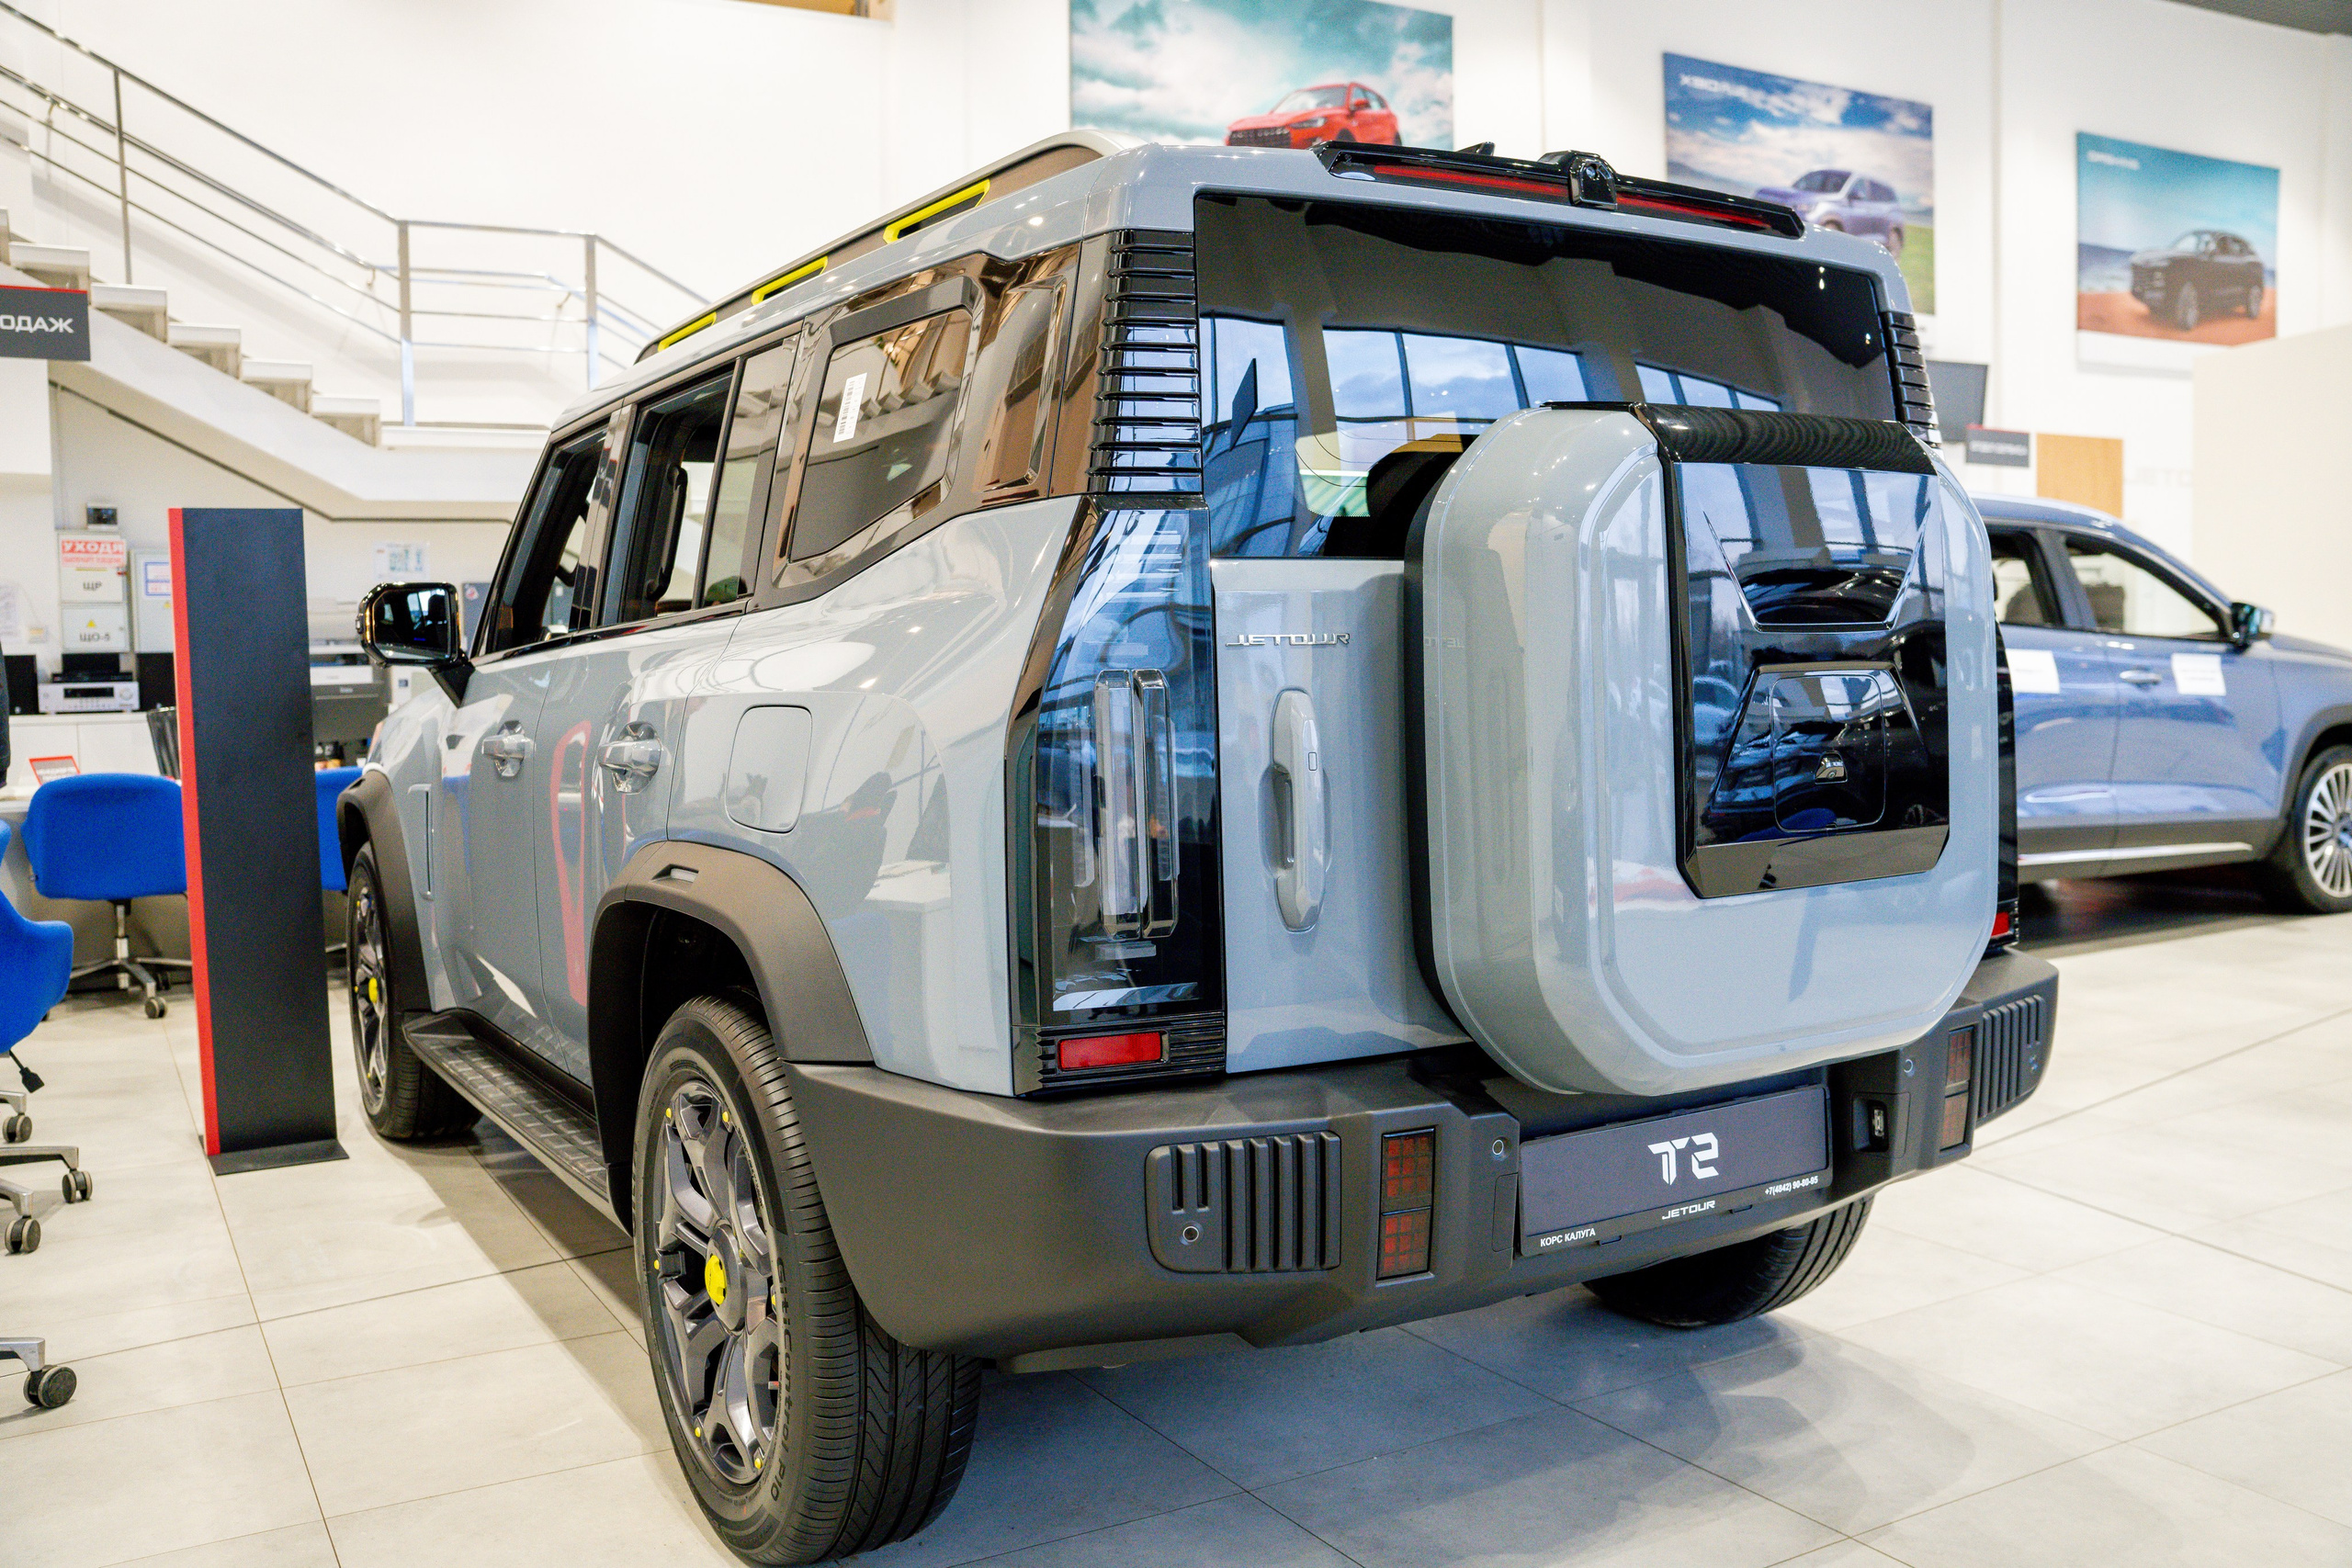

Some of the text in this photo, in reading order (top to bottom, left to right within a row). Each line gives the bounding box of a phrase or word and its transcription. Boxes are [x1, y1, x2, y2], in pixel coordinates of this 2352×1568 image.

[1227, 633, 1351, 646] JETOUR
[1647, 1133, 1719, 1185] T2
[1765, 1183, 1792, 1196] +7(4842)
[1662, 1200, 1715, 1220] JETOUR
[1540, 1228, 1596, 1247] КОРС КАЛУГА
